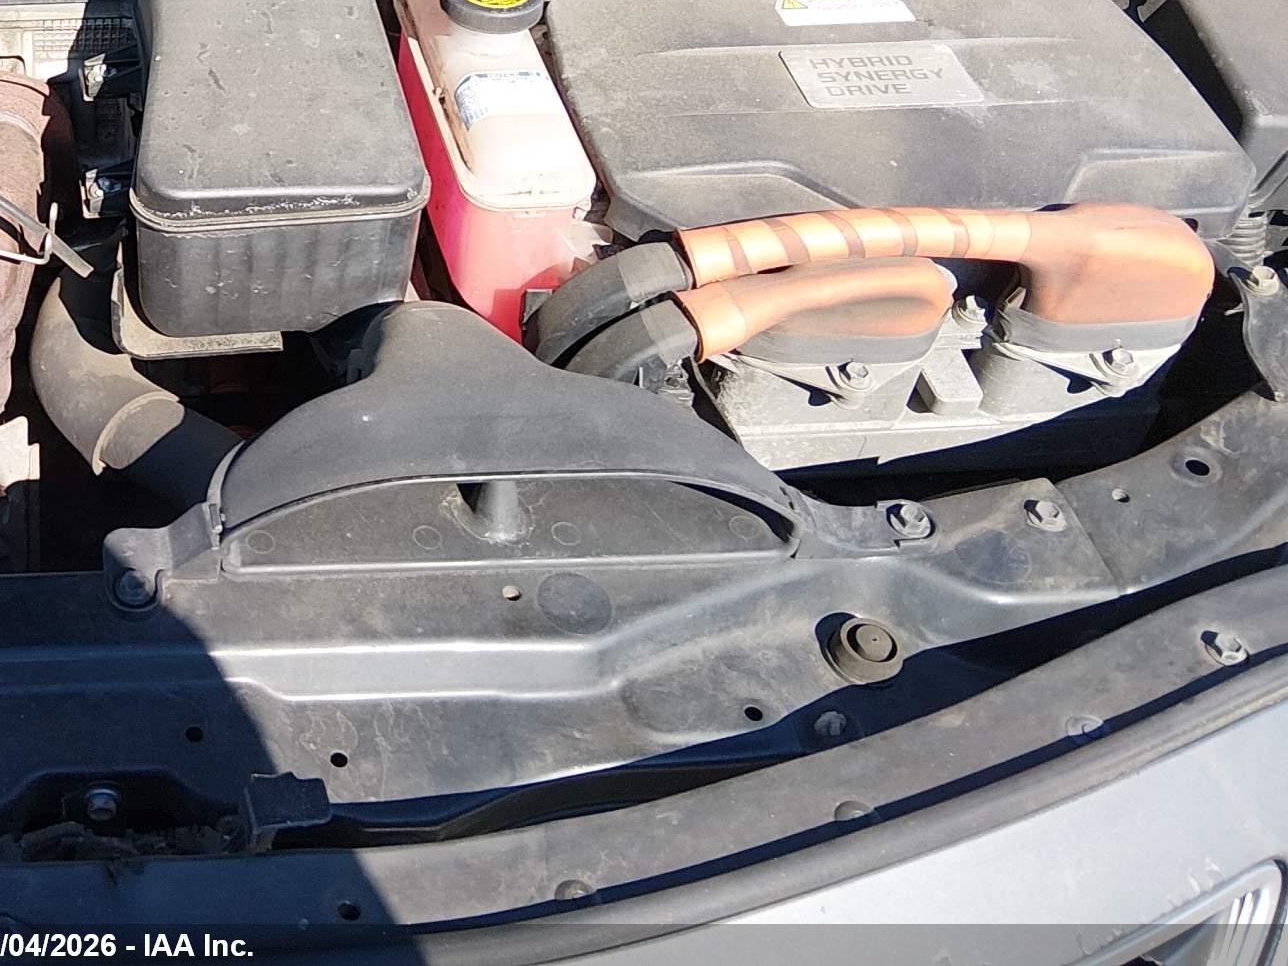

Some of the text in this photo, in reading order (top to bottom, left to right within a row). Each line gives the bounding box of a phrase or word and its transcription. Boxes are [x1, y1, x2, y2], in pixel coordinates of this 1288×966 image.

[809, 55, 913, 70] HYBRID
[817, 68, 944, 84] SYNERGY
[827, 83, 911, 97] DRIVE
